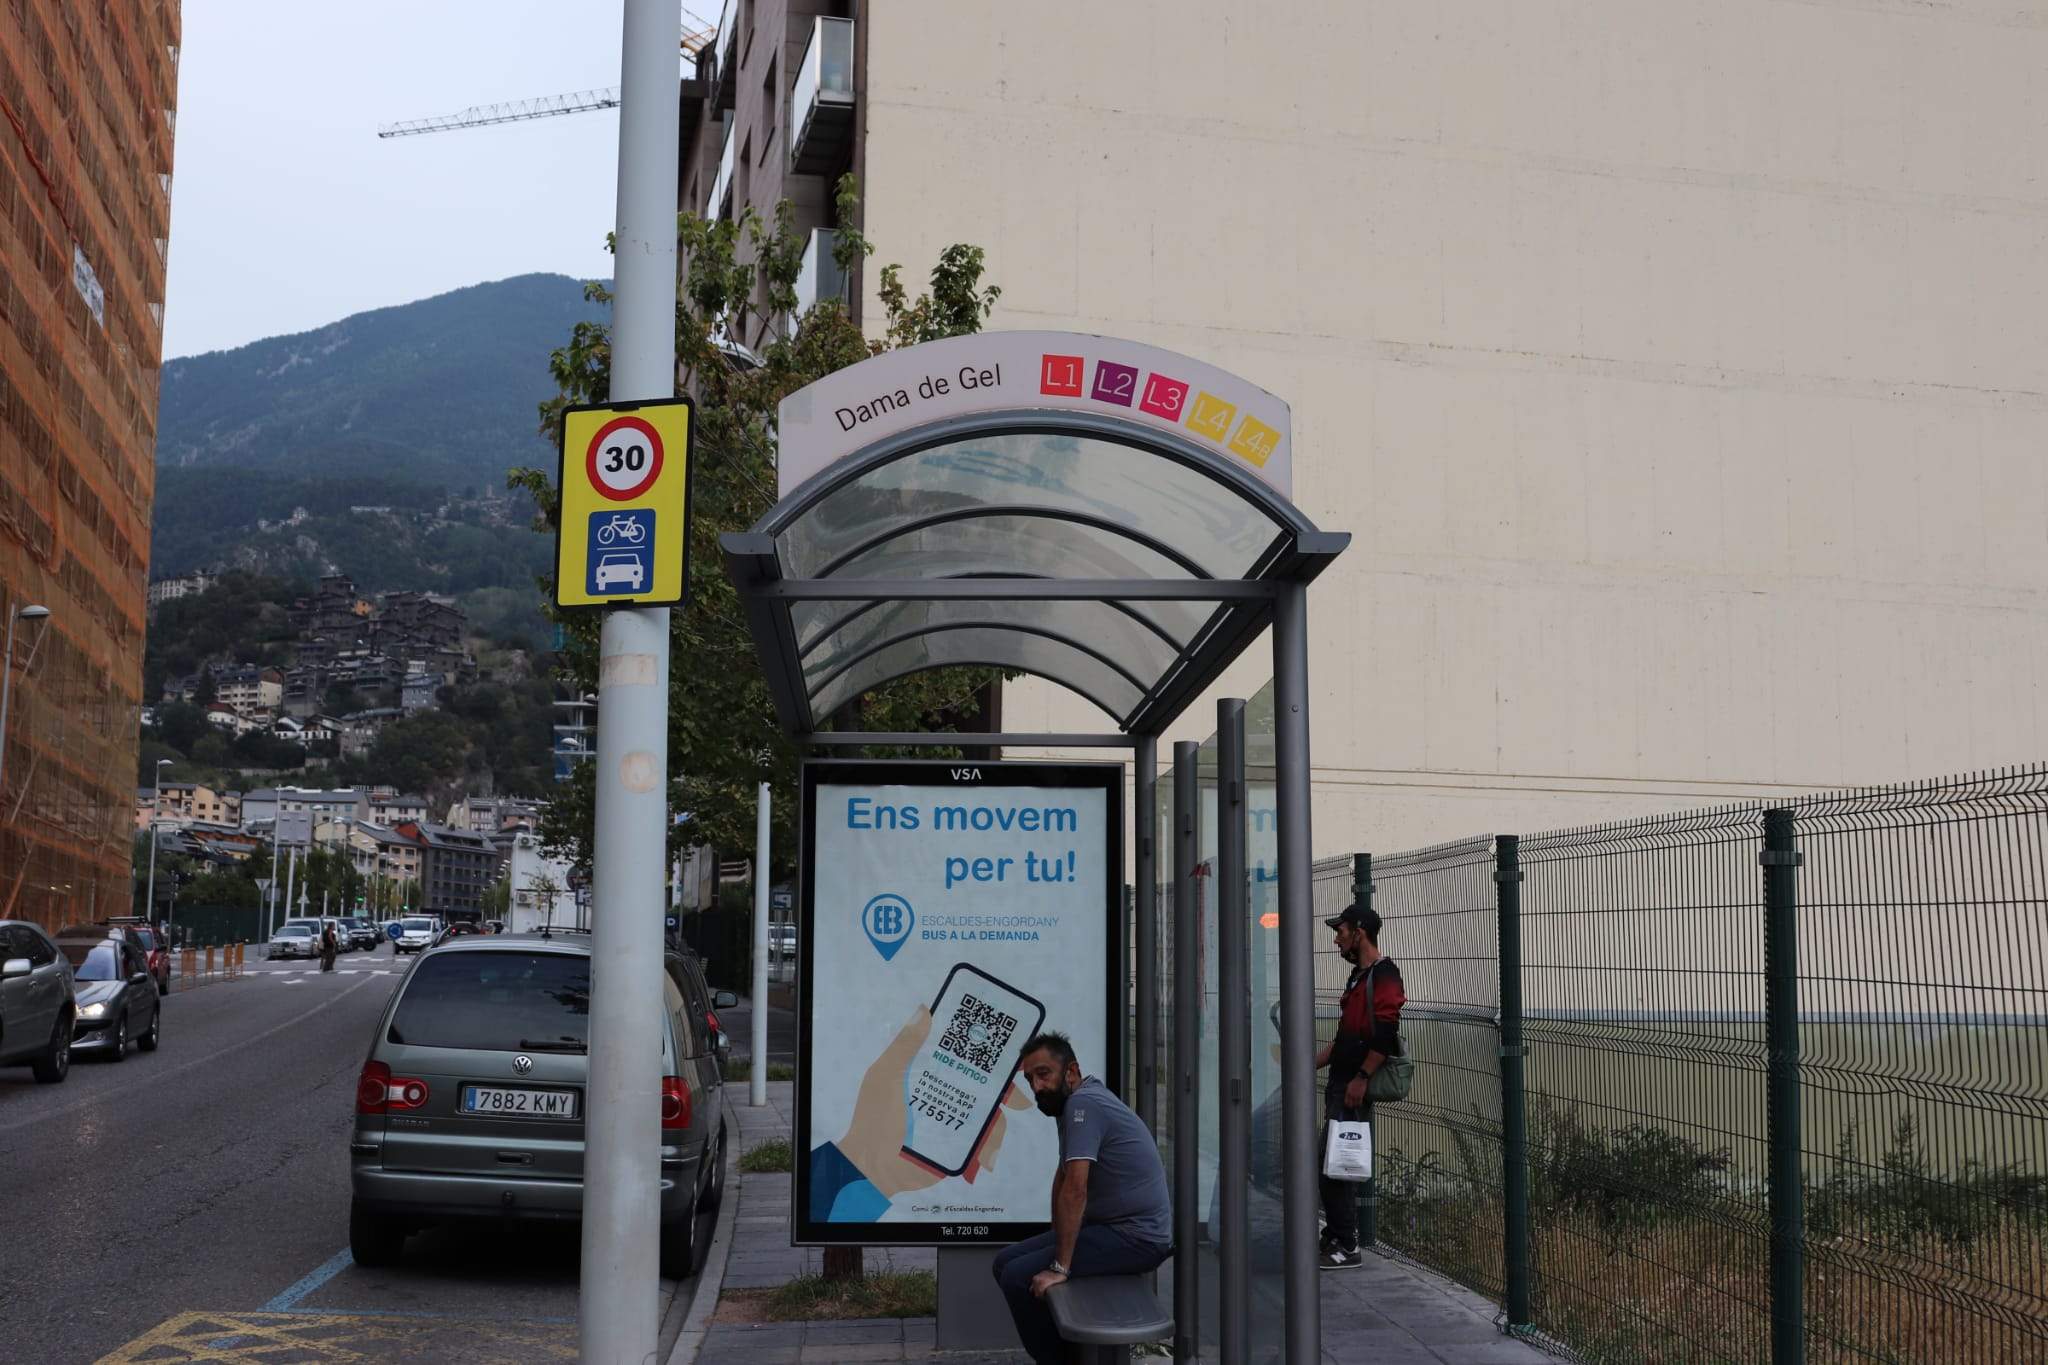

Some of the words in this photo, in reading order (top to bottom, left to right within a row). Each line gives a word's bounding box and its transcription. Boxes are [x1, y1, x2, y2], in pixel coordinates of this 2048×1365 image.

[834, 391, 911, 433] Dama
[917, 374, 950, 399] de
[958, 362, 1002, 390] Gel
[1045, 361, 1077, 388] L1
[1097, 370, 1133, 397] L2
[1145, 381, 1180, 412] L3
[1194, 400, 1227, 431] L4
[604, 445, 645, 473] 30
[950, 768, 982, 781] VSA
[847, 797, 920, 829] Ens
[933, 806, 1077, 832] movem
[945, 855, 1013, 889] per
[1025, 850, 1076, 883] tu!
[922, 916, 1059, 928] ESCALDES-ENGORDANY
[922, 931, 946, 941] BUS
[950, 931, 958, 941] A
[963, 931, 976, 941] LA
[980, 931, 1039, 942] DEMANDA
[932, 1051, 956, 1067] RIDE
[918, 1078, 927, 1087] la
[928, 1084, 954, 1102] nostra
[956, 1098, 974, 1110] APP
[922, 1070, 977, 1103] Descarrega't
[480, 1092, 527, 1111] 7882
[533, 1095, 570, 1113] KMY
[908, 1095, 965, 1131] 775577
[922, 1091, 958, 1114] reserva
[959, 1110, 970, 1120] al
[942, 1226, 955, 1236] Tel.
[957, 1226, 972, 1235] 720
[973, 1226, 989, 1235] 620
